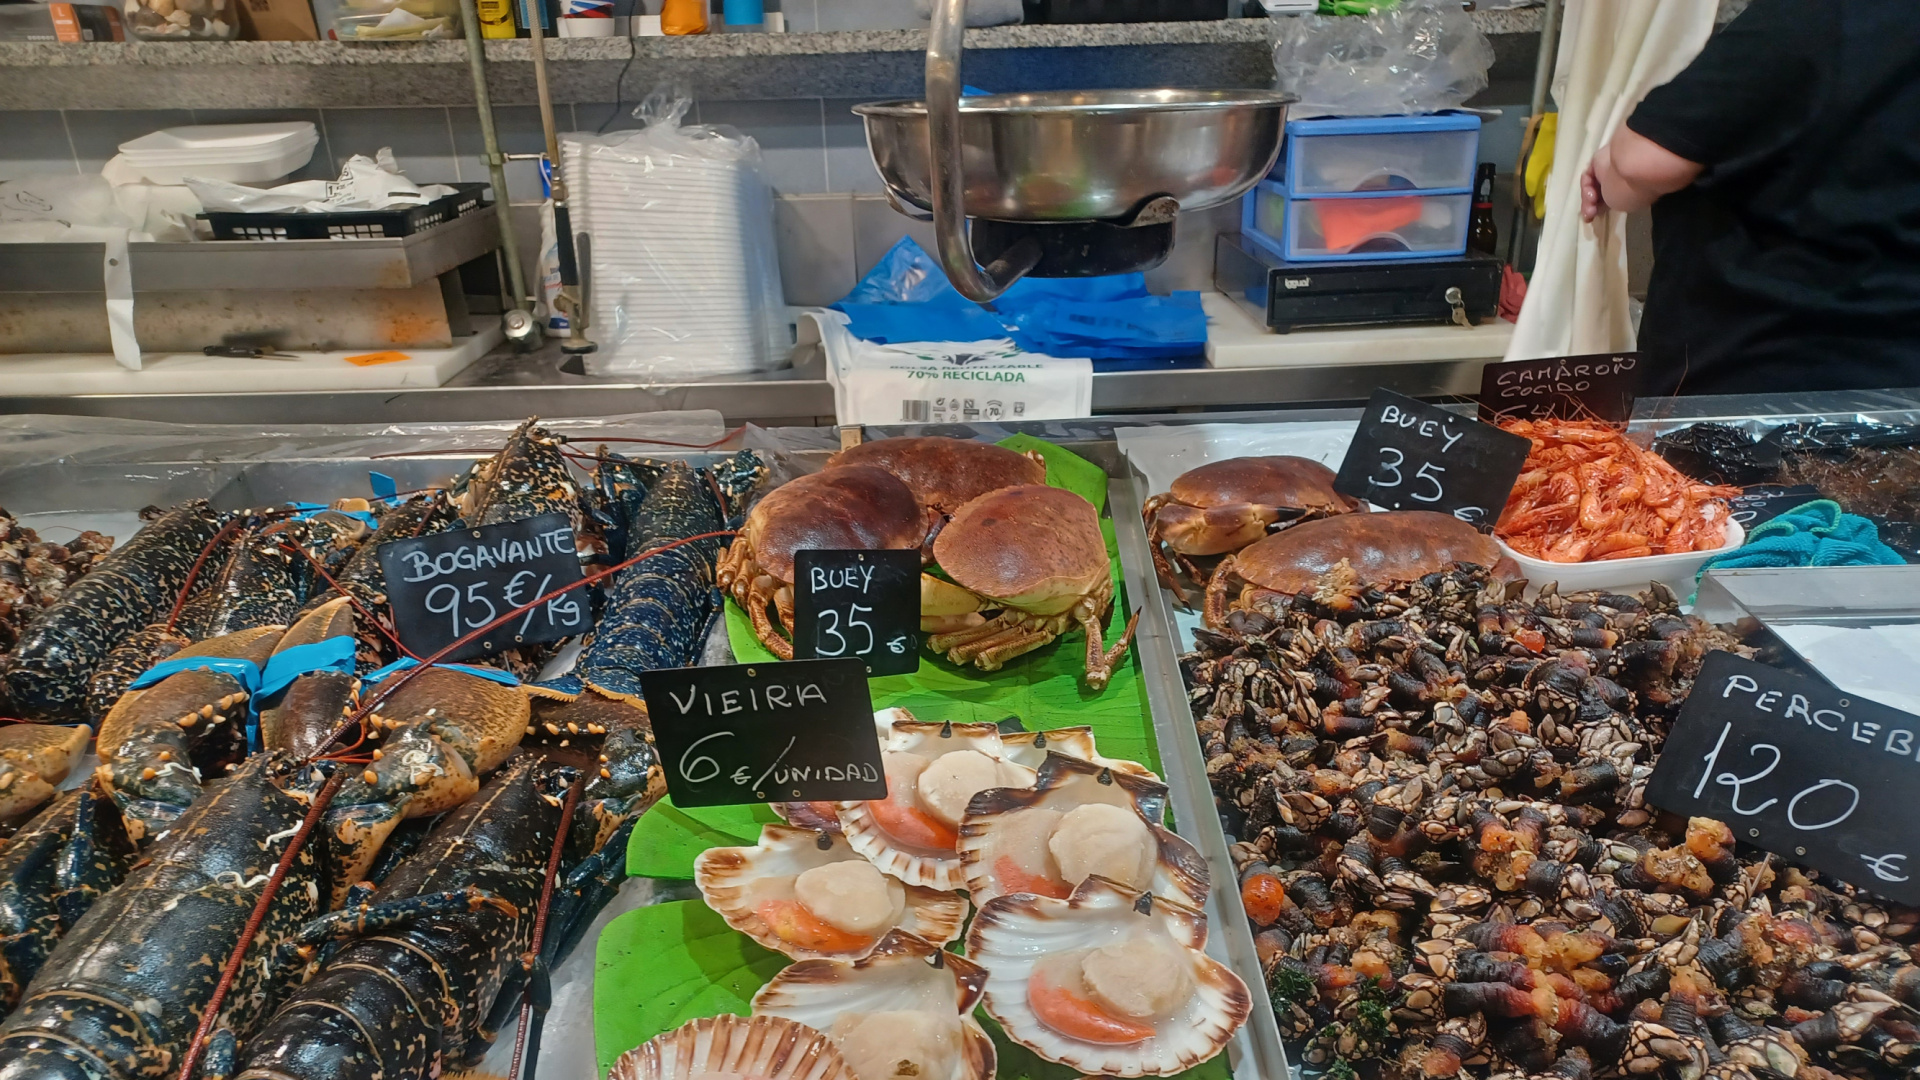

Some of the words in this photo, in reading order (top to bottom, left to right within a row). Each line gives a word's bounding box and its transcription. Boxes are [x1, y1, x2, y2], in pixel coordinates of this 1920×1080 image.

[942, 370, 1026, 383] RECICLADA
[1500, 380, 1591, 398] COCIDO
[1380, 405, 1464, 453] BUEY
[1368, 447, 1446, 502] 35
[401, 527, 576, 583] BOGAVANTE
[810, 564, 875, 594] BUEY
[815, 602, 873, 656] 35
[886, 636, 907, 654] €
[669, 684, 827, 716] VIEIRA
[1722, 674, 1920, 763] PERCEB
[1693, 721, 1860, 830] 120
[1860, 853, 1910, 882] €
